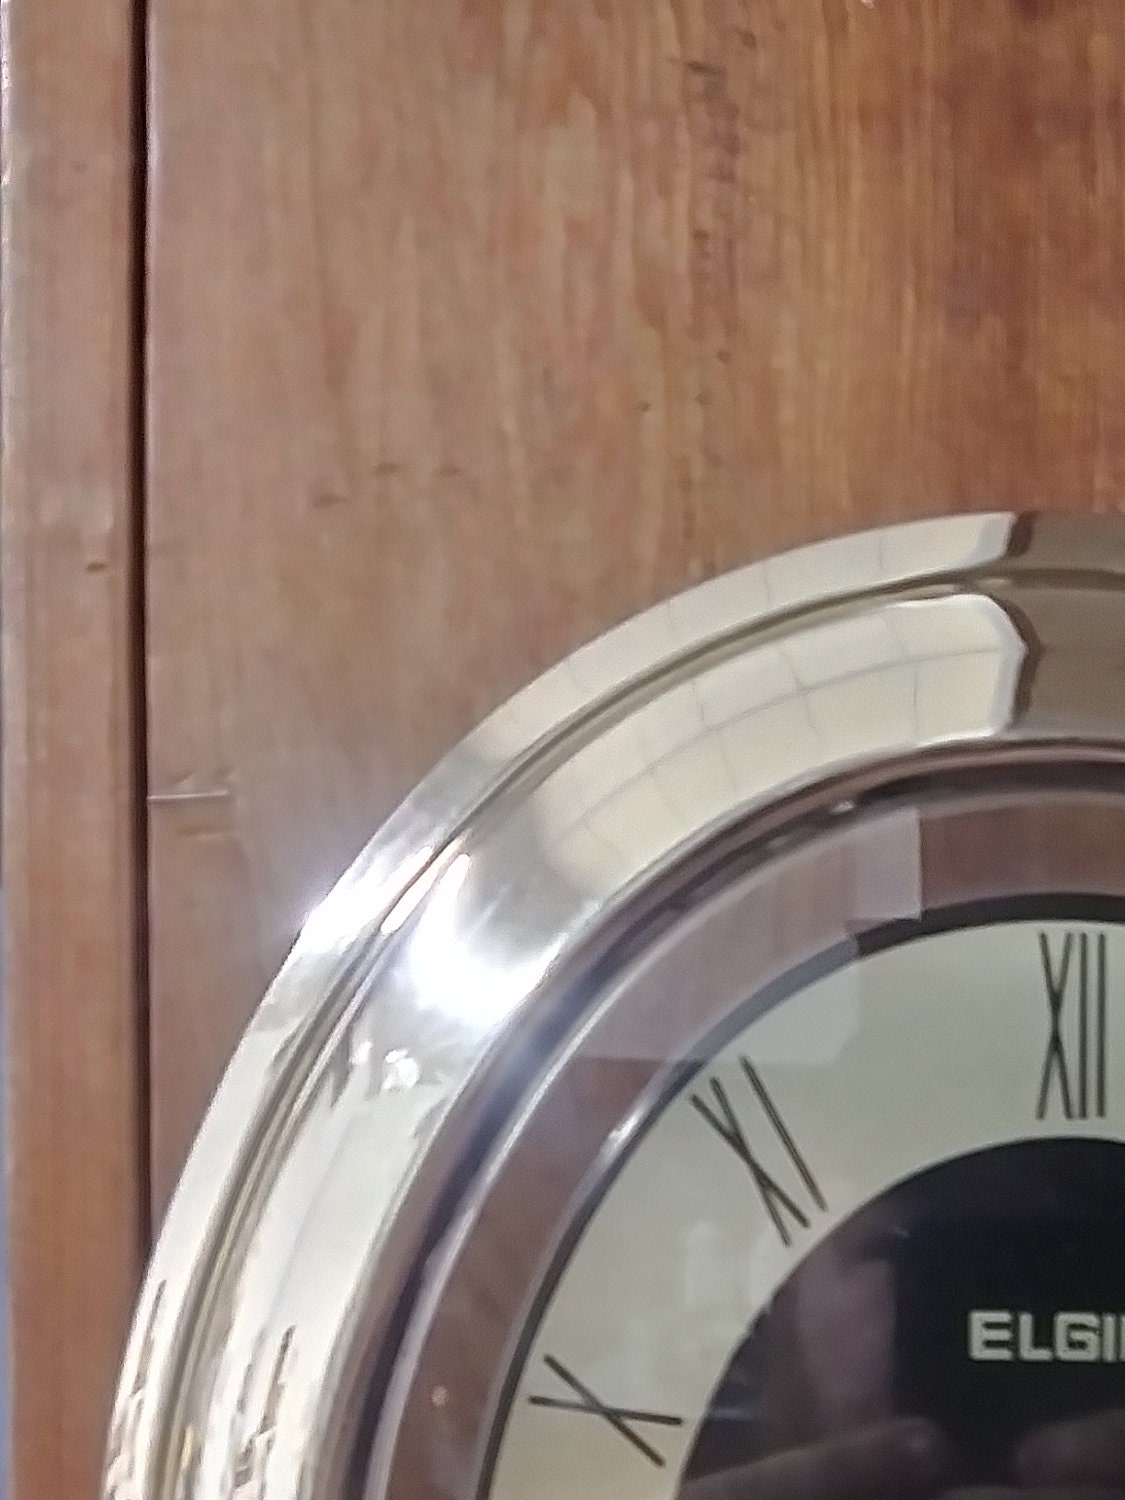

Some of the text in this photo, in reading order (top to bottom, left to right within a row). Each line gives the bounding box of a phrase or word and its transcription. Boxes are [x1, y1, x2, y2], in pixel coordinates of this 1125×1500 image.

[1036, 932, 1106, 1121] XII
[690, 1056, 828, 1246] XI
[529, 1354, 683, 1467] X
